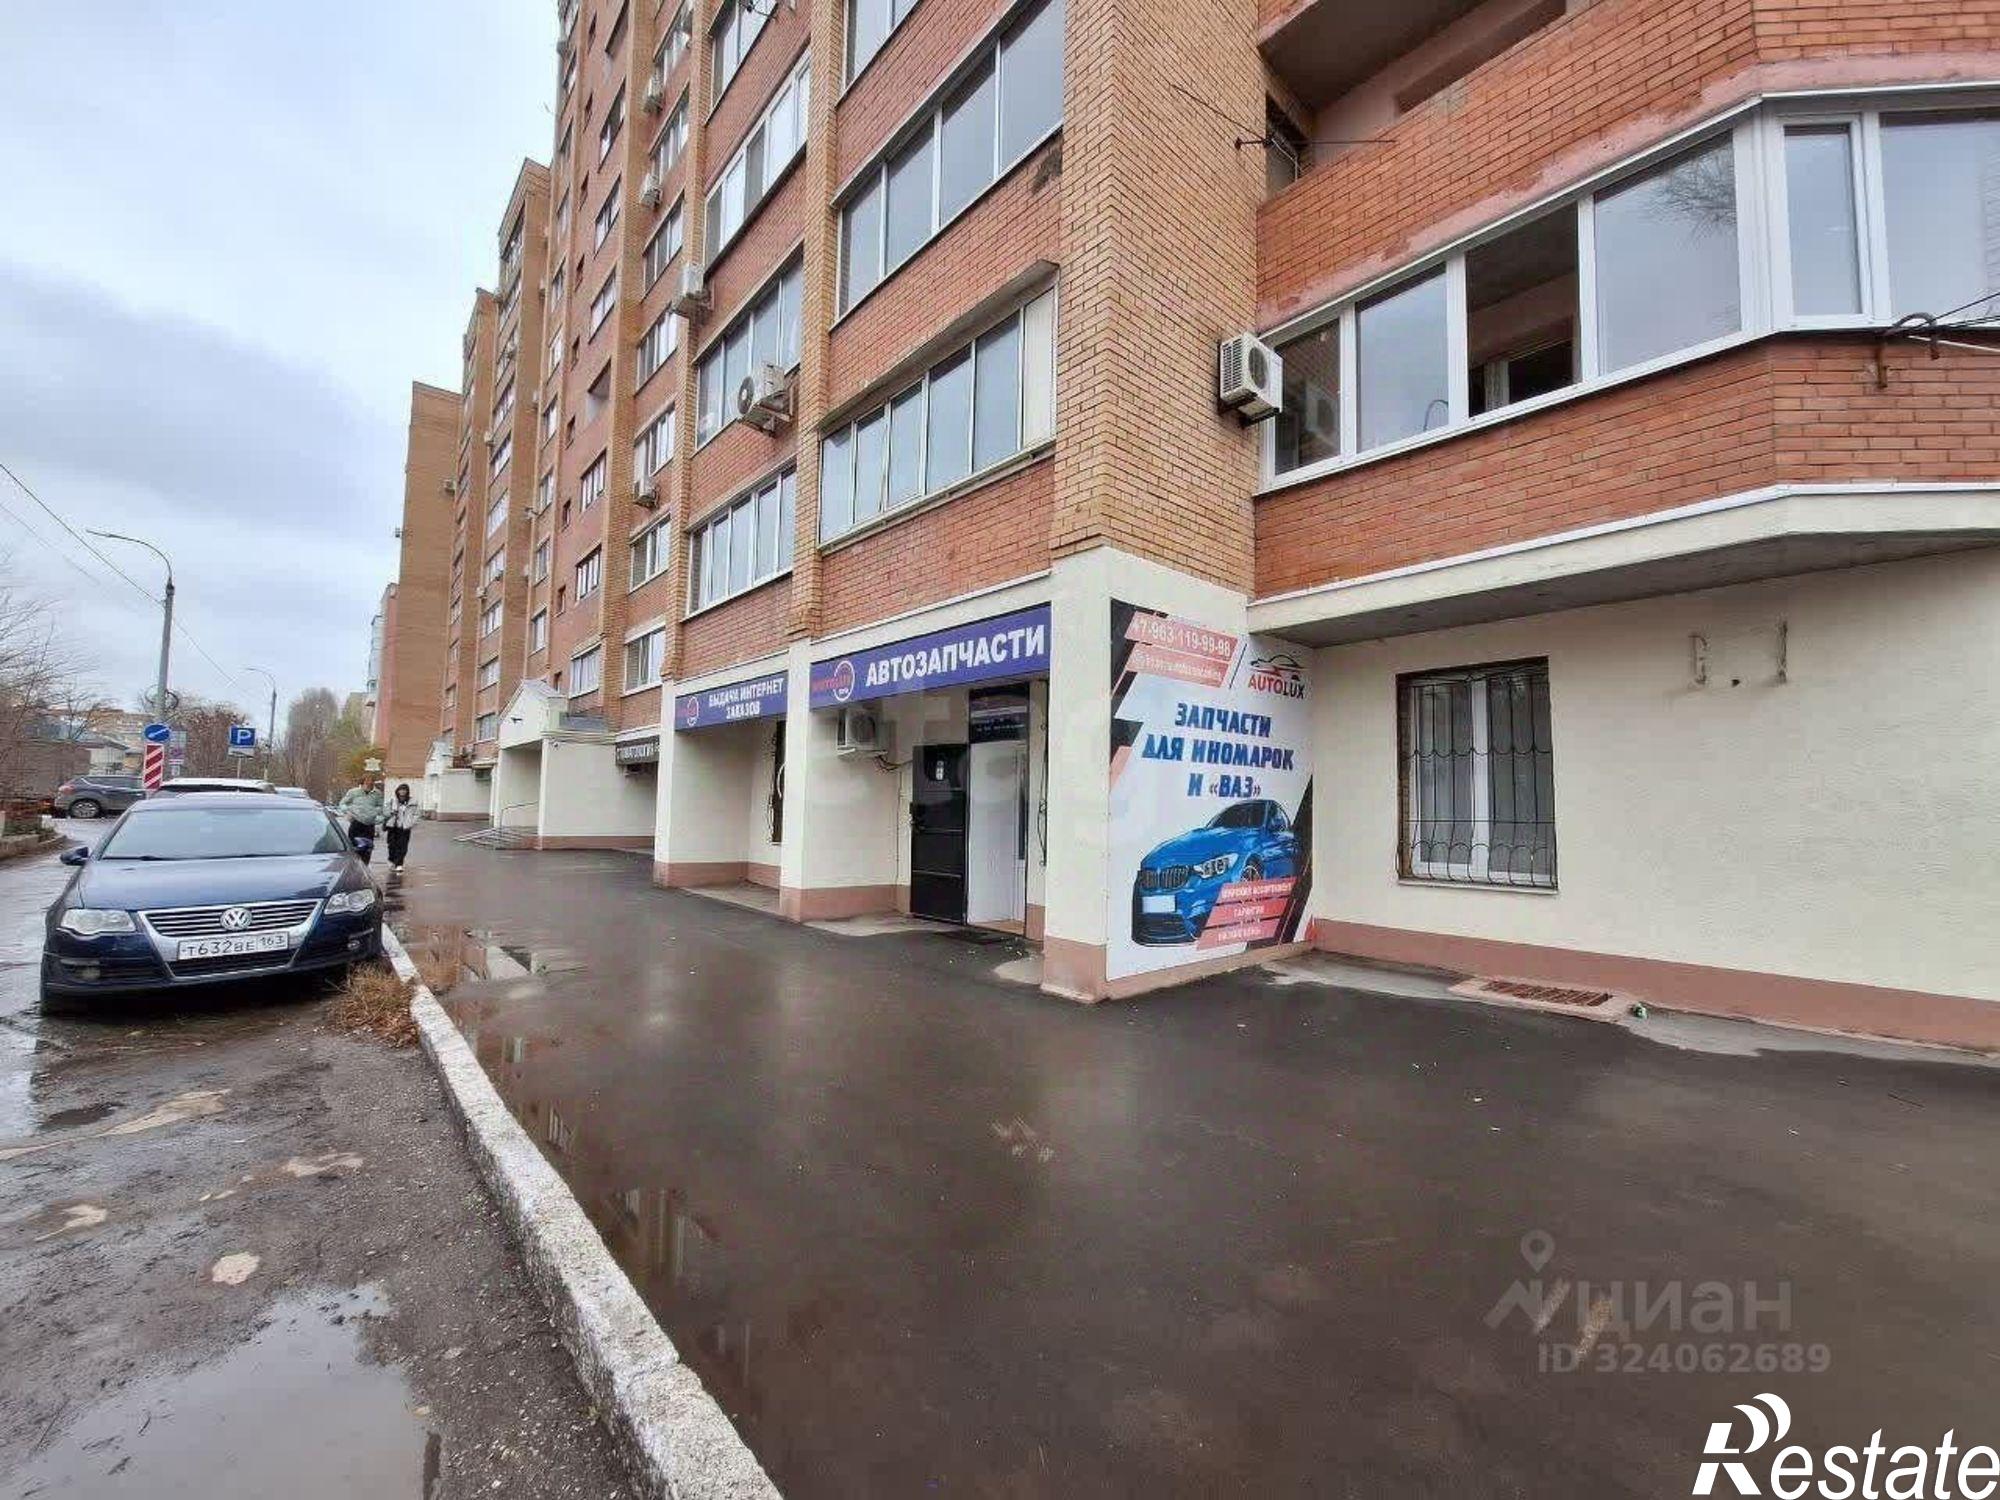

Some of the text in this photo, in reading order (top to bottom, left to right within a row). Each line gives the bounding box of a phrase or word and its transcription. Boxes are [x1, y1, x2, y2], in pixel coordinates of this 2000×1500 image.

[865, 624, 1045, 687] АВТОЗАПЧАСТИ
[740, 678, 785, 702] ИНТЕРНЕТ
[1248, 674, 1305, 699] AUTOLUX
[726, 701, 761, 720] ЗАКАЗОВ
[1174, 702, 1271, 738] ЗАПЧАСТИ
[237, 729, 251, 744] P
[1142, 733, 1295, 772] ДЛЯ ИНОМАРОК
[1187, 773, 1204, 797] И
